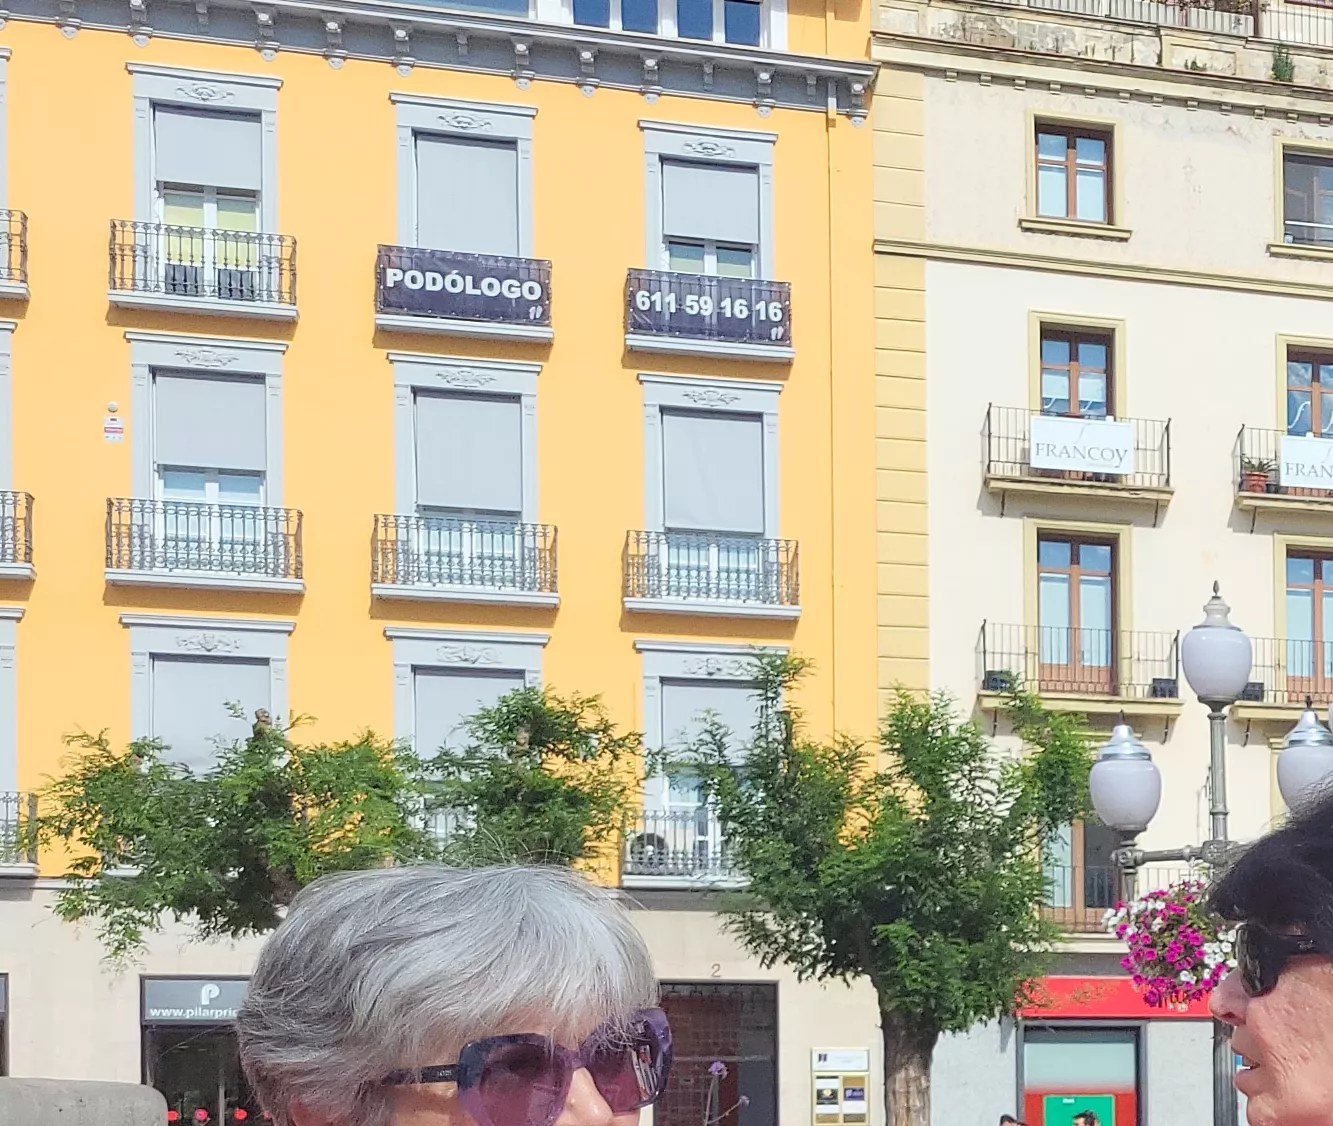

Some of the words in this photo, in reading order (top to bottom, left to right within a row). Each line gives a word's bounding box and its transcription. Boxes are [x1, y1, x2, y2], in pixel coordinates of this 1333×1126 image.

[386, 268, 542, 300] PODÓLOGO
[635, 290, 677, 313] 611
[685, 294, 714, 316] 59
[720, 297, 749, 319] 16
[755, 300, 783, 322] 16
[711, 963, 721, 977] 2
[201, 983, 220, 1005] P
